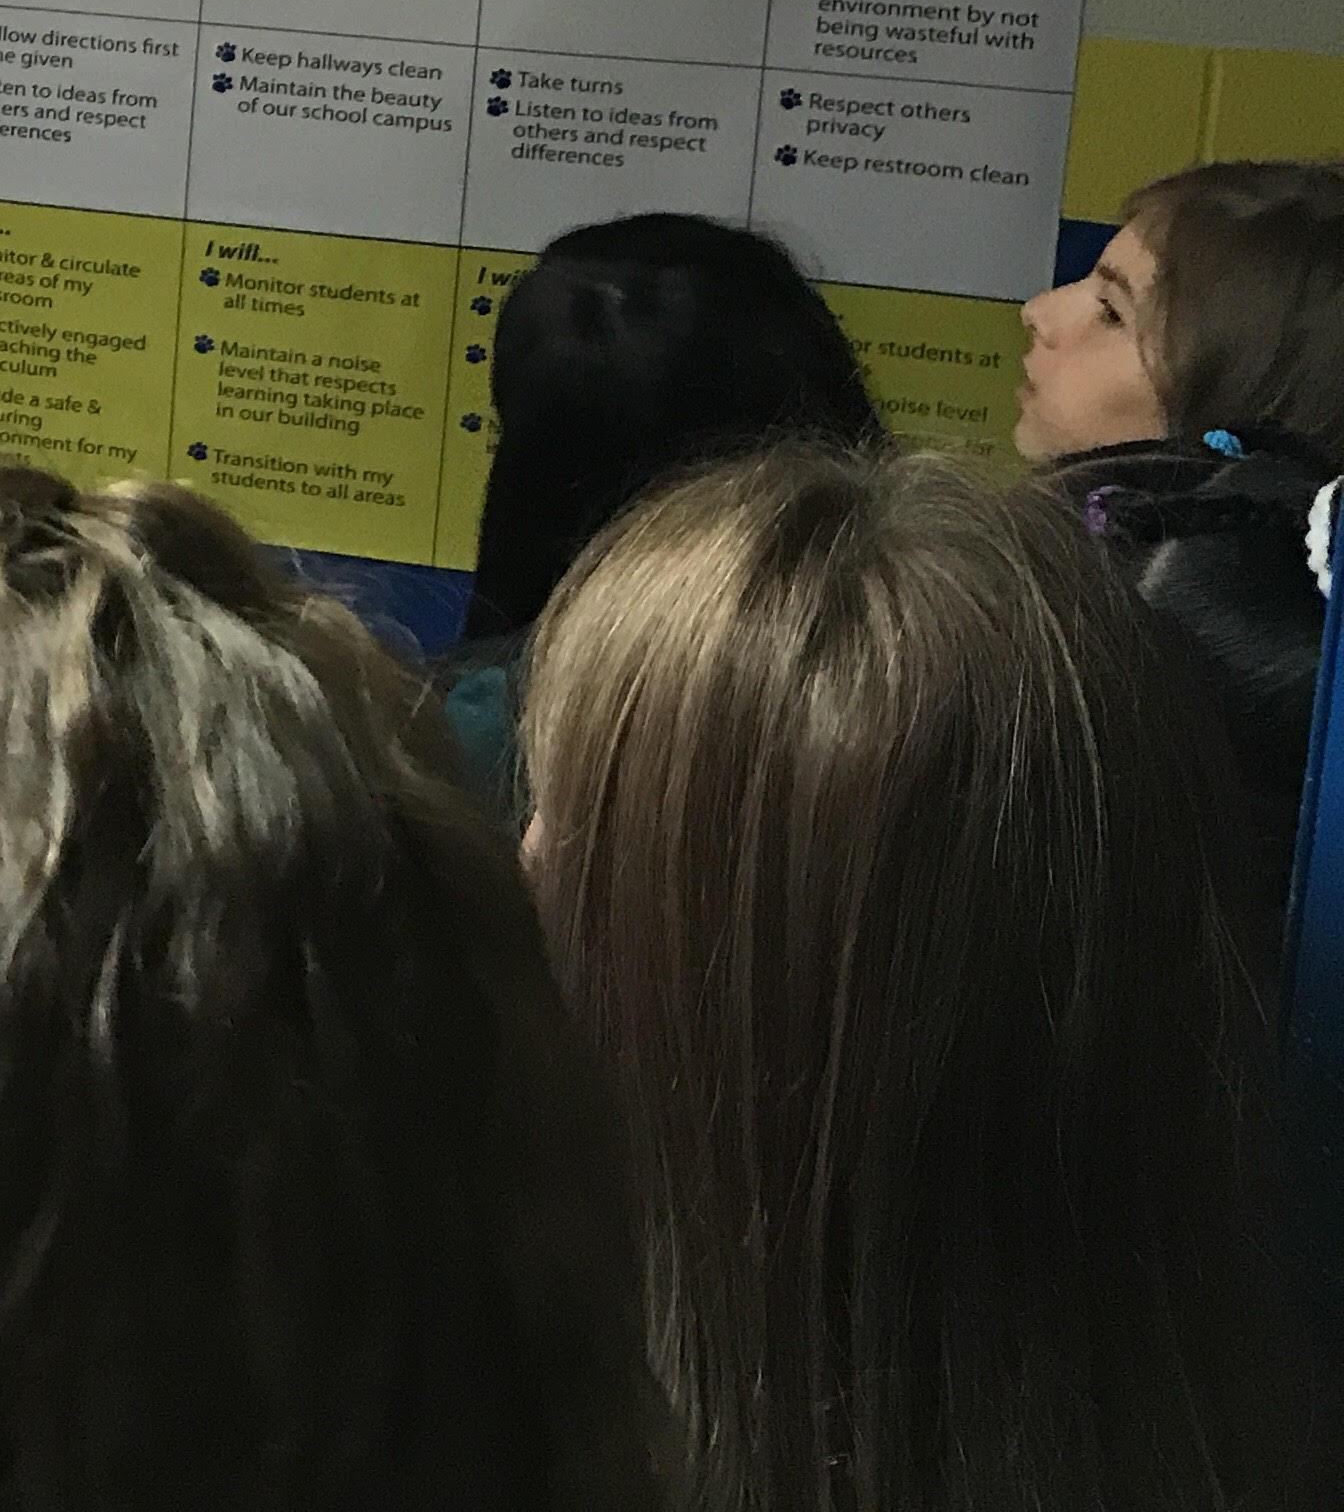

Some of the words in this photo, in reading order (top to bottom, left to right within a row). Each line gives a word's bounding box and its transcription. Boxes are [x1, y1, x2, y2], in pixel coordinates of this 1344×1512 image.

[41, 29, 137, 54] directions
[142, 37, 179, 57] first
[241, 47, 292, 70] Keep
[296, 51, 383, 78] hallways
[387, 60, 443, 80] clean
[517, 70, 565, 91] Take
[570, 77, 623, 95] turns
[512, 123, 579, 143] others
[583, 128, 625, 146] and
[628, 134, 707, 153] respect
[805, 117, 886, 143] privacy
[803, 149, 859, 173] Keep
[863, 158, 964, 180] restroom
[969, 164, 1030, 186] clean
[877, 341, 973, 366] students
[978, 351, 1001, 369] at
